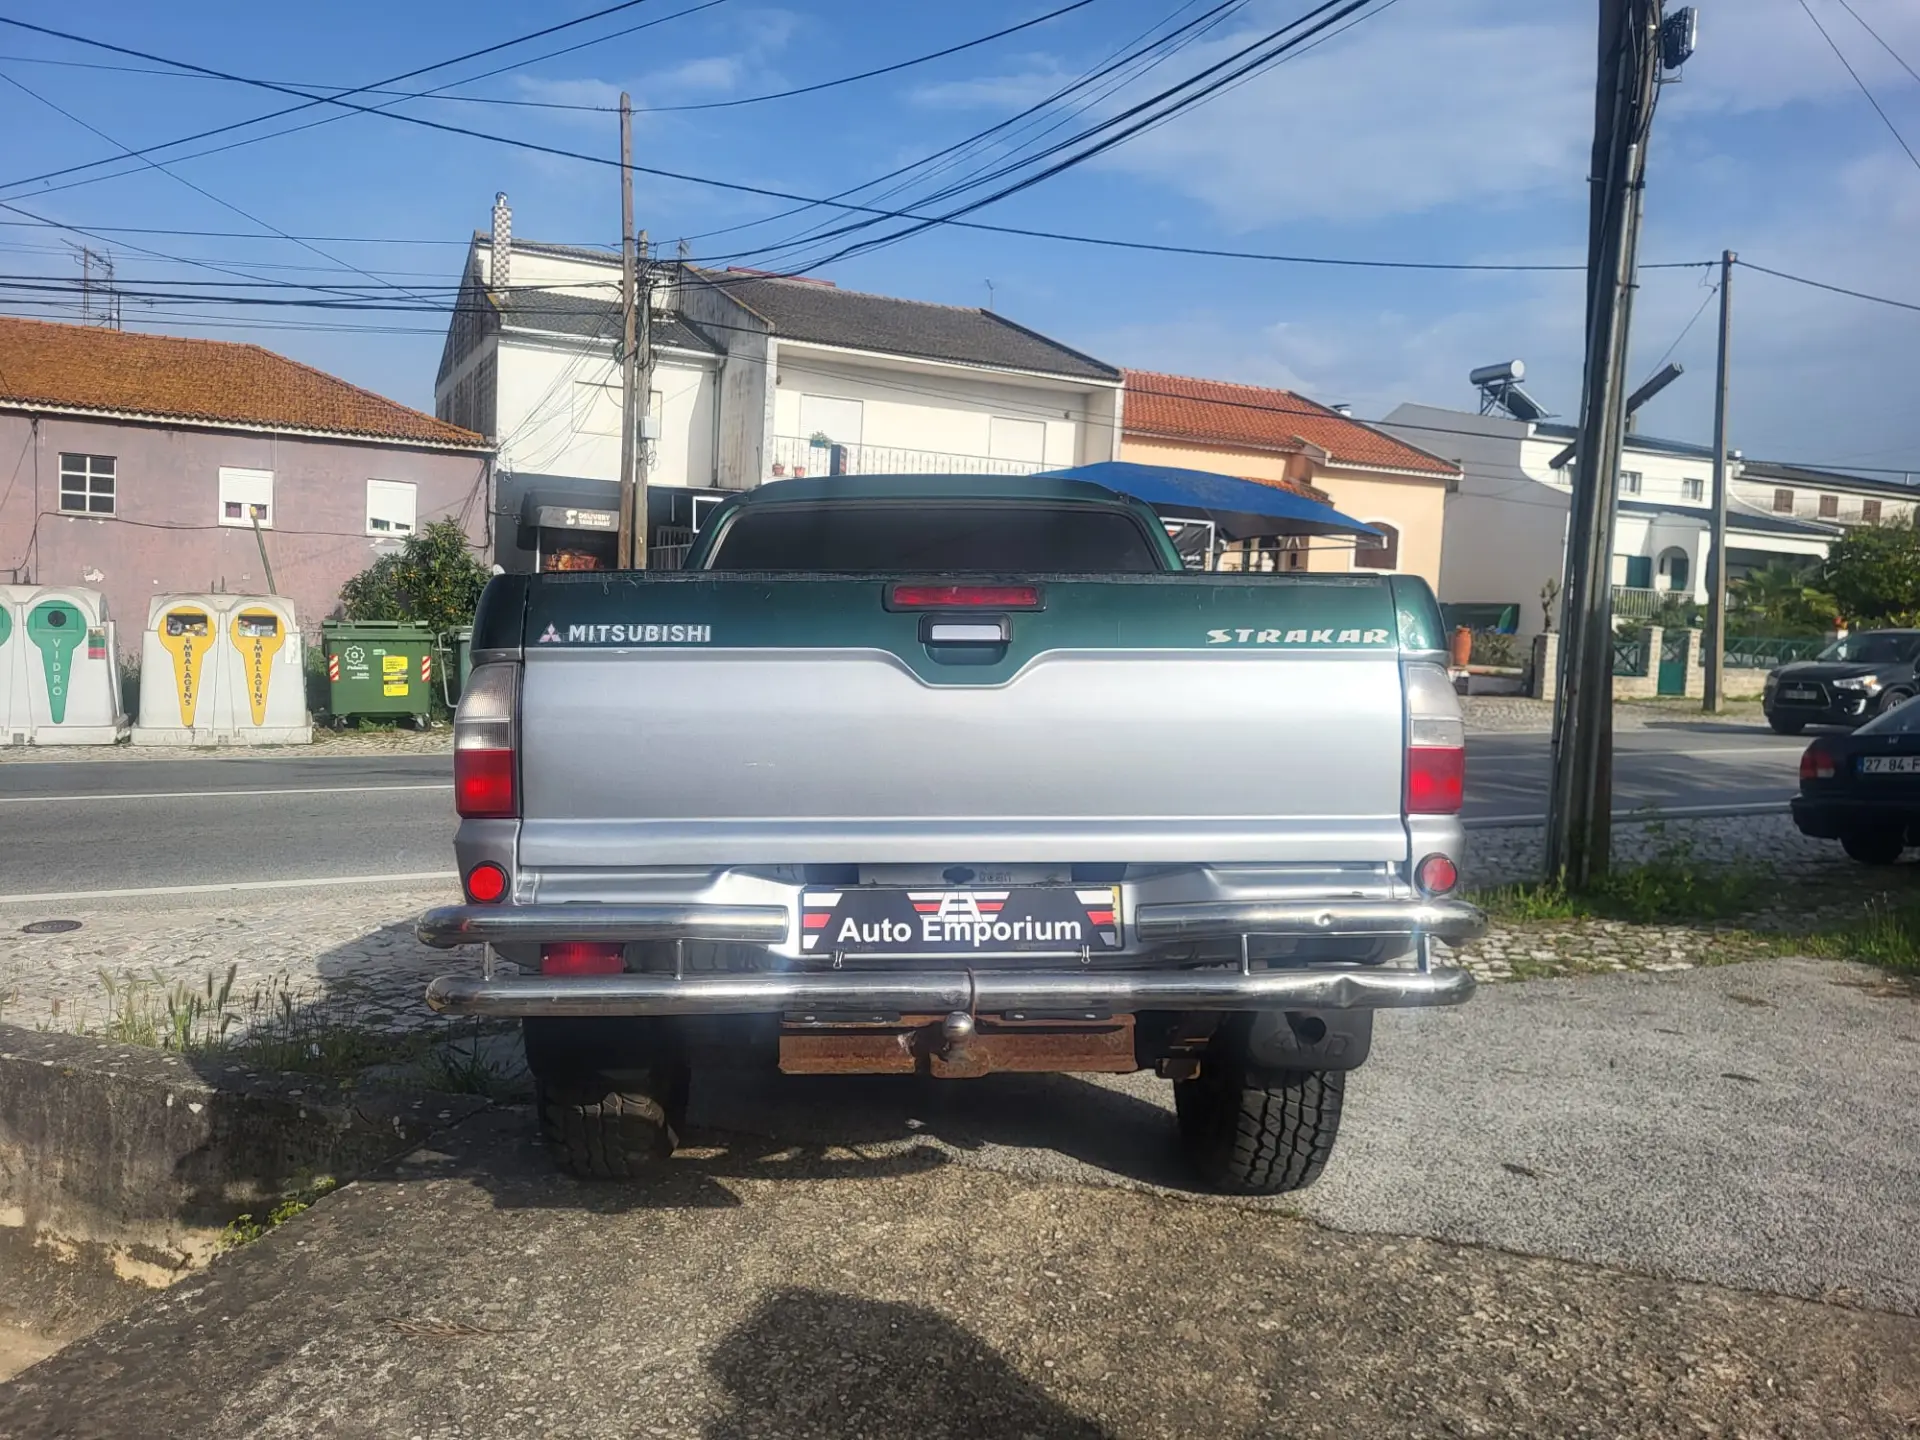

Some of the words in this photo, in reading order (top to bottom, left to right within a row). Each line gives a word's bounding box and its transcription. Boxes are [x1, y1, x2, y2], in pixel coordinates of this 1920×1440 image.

[569, 624, 711, 643] MITSUBISHI
[1206, 628, 1389, 644] STRAKAR
[52, 638, 62, 696] VIDRO
[183, 637, 193, 706] EMBALAGENS
[253, 638, 263, 706] EMBALAGENS
[837, 917, 912, 943] Auto
[922, 915, 1082, 947] Emporium
